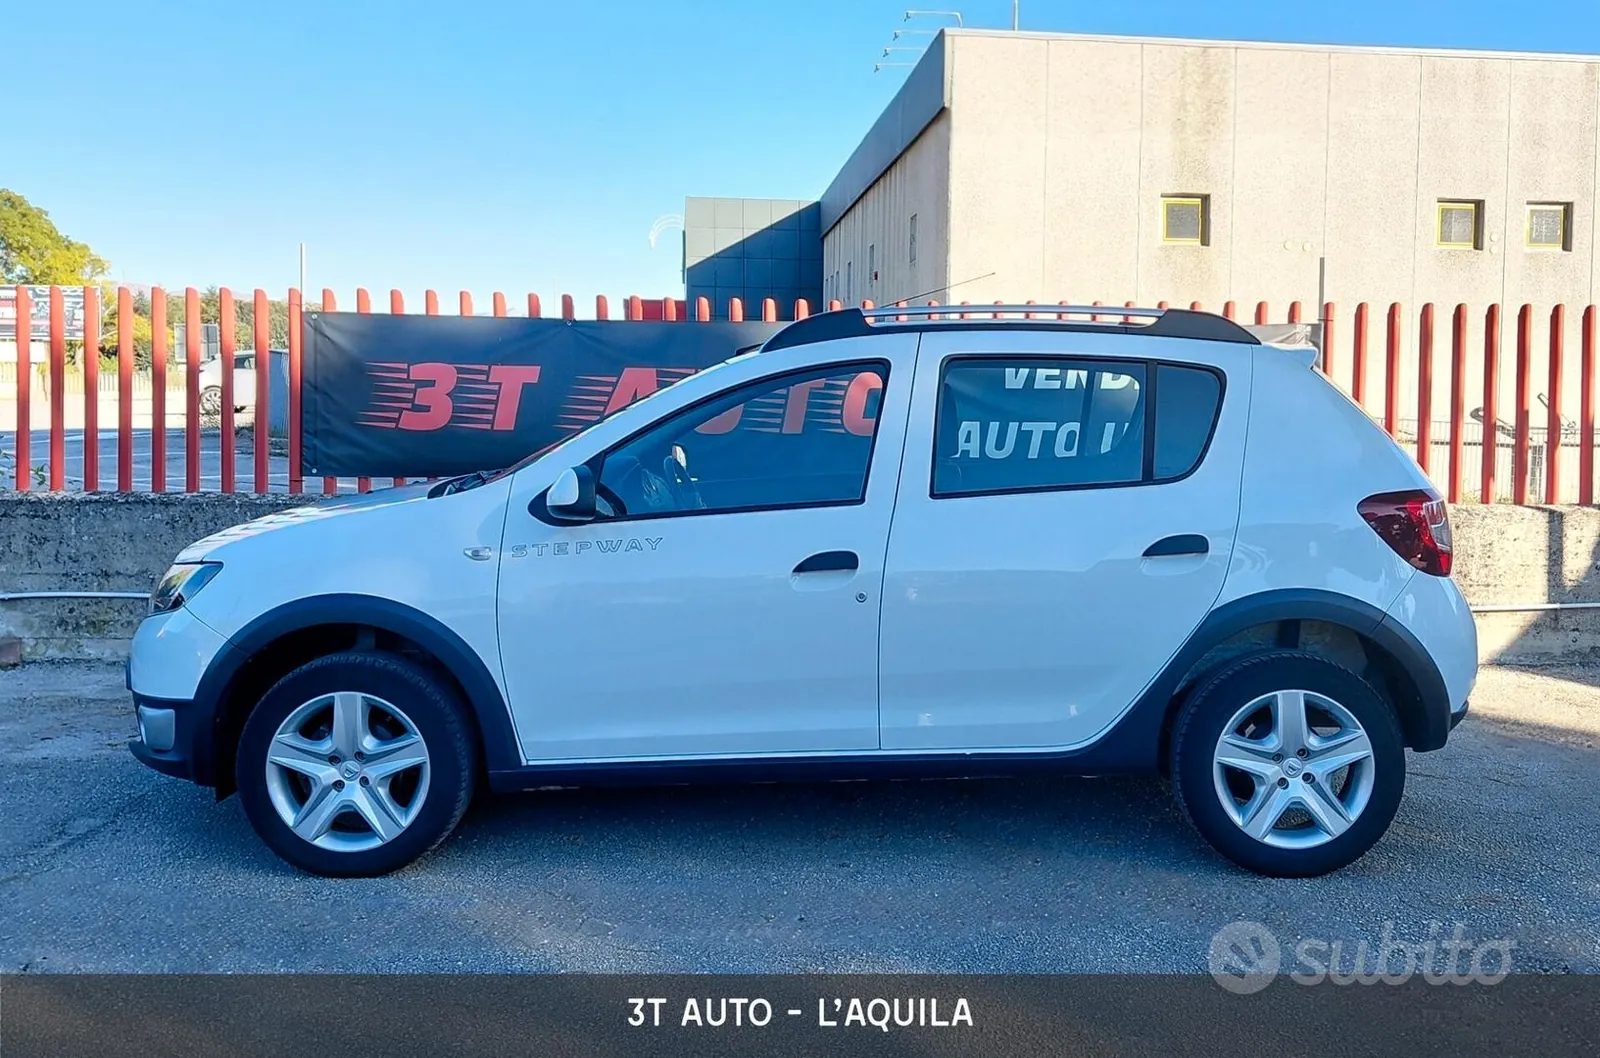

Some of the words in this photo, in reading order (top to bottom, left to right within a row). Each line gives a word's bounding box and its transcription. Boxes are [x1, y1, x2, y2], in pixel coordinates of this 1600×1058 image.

[398, 362, 542, 431] 3T
[950, 421, 1082, 459] AUTO
[511, 537, 663, 558] STEPWAY
